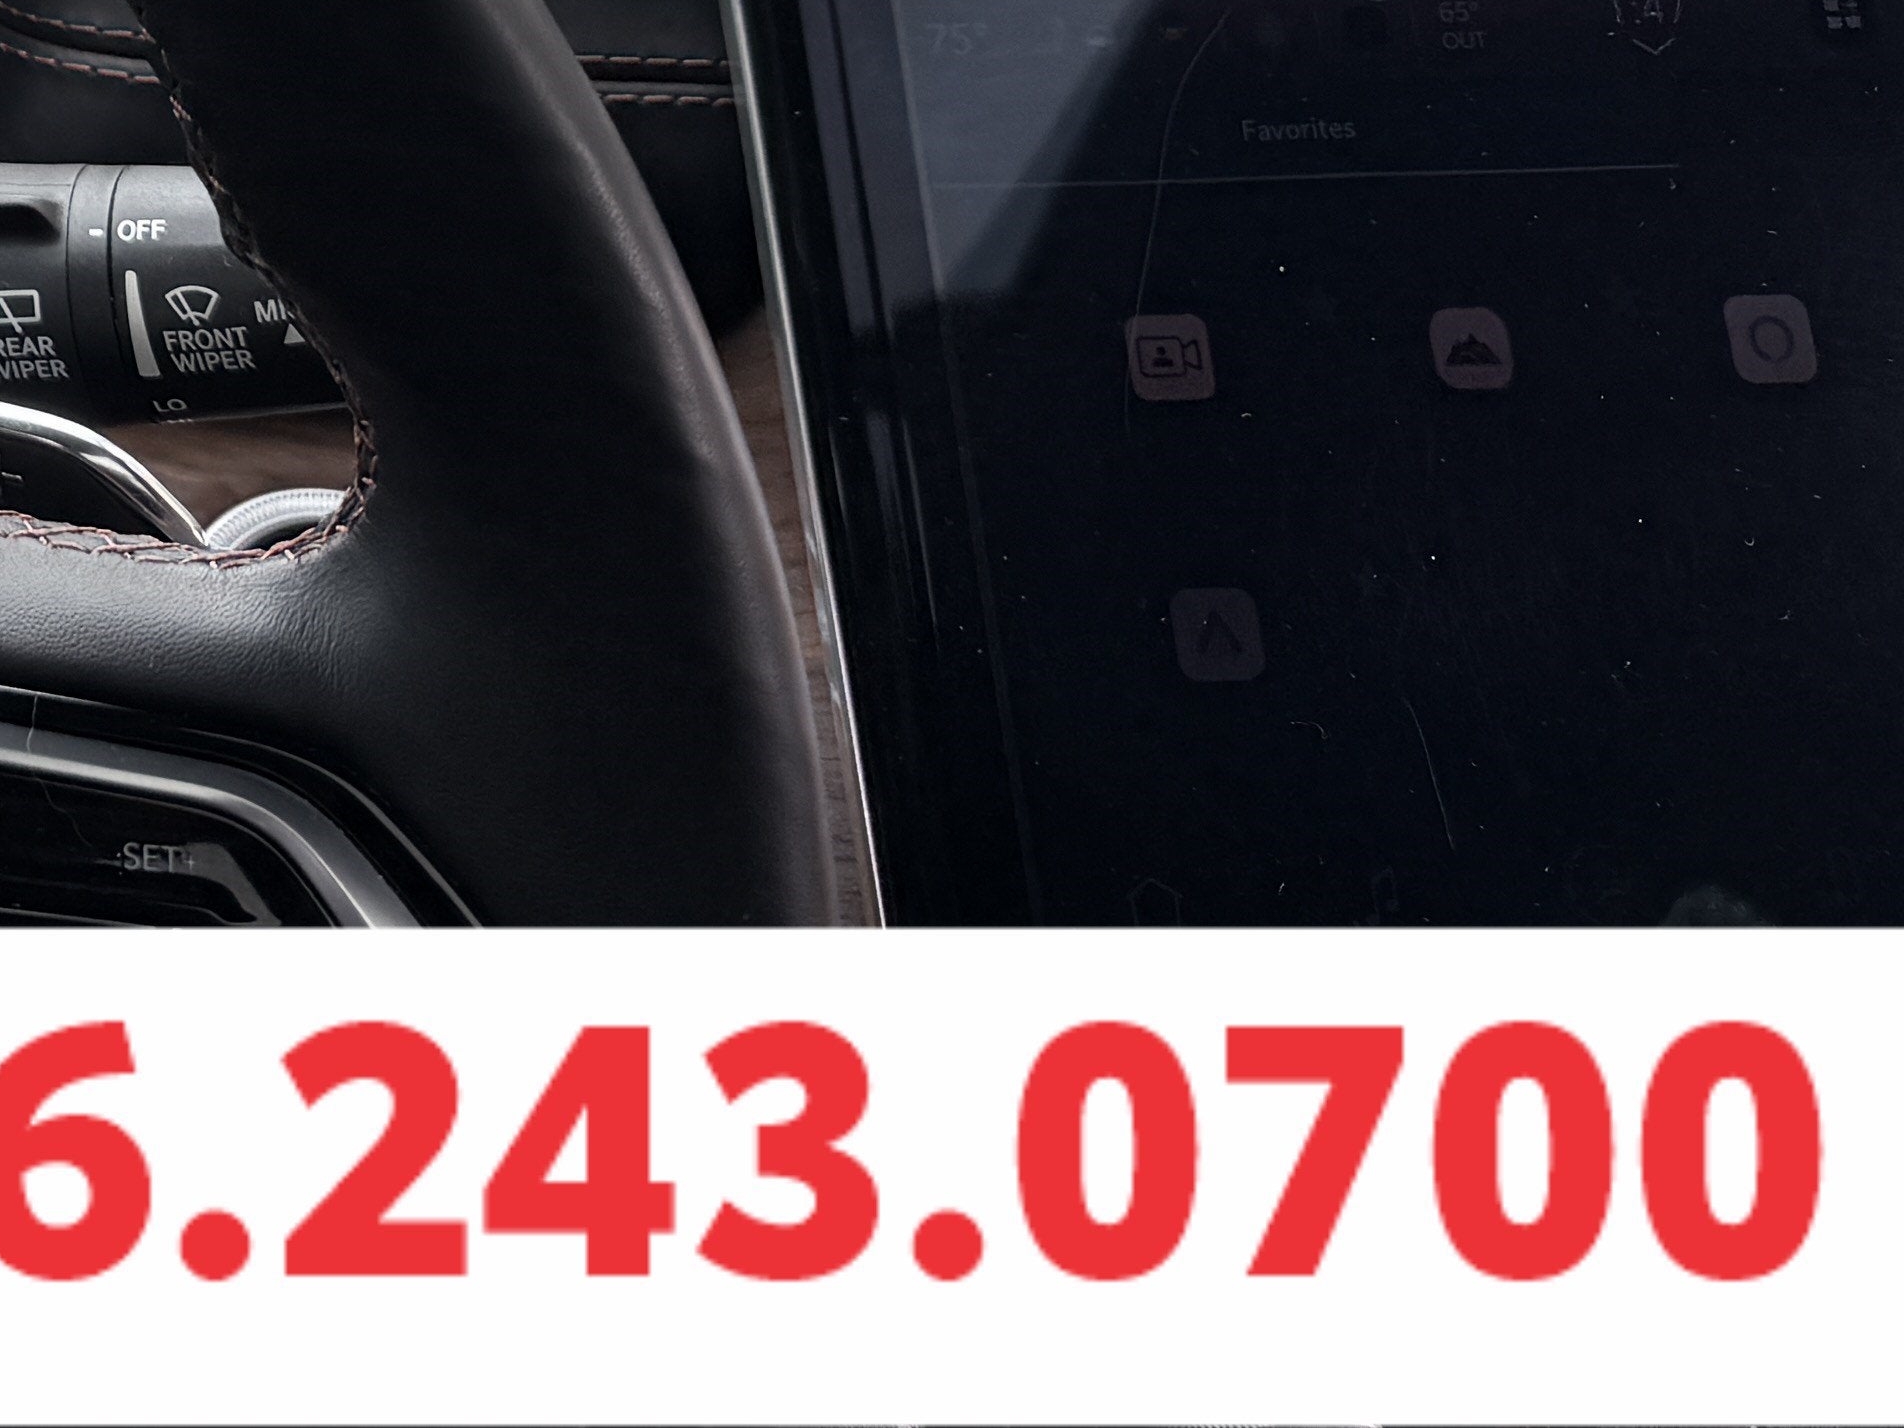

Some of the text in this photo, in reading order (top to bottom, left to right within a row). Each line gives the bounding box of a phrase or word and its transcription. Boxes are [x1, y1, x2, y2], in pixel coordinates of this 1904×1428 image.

[1240, 117, 1357, 144] Favorites
[116, 218, 169, 242] OFF
[162, 325, 249, 352] FRONT
[170, 350, 258, 374] WIPER
[152, 398, 188, 414] LO
